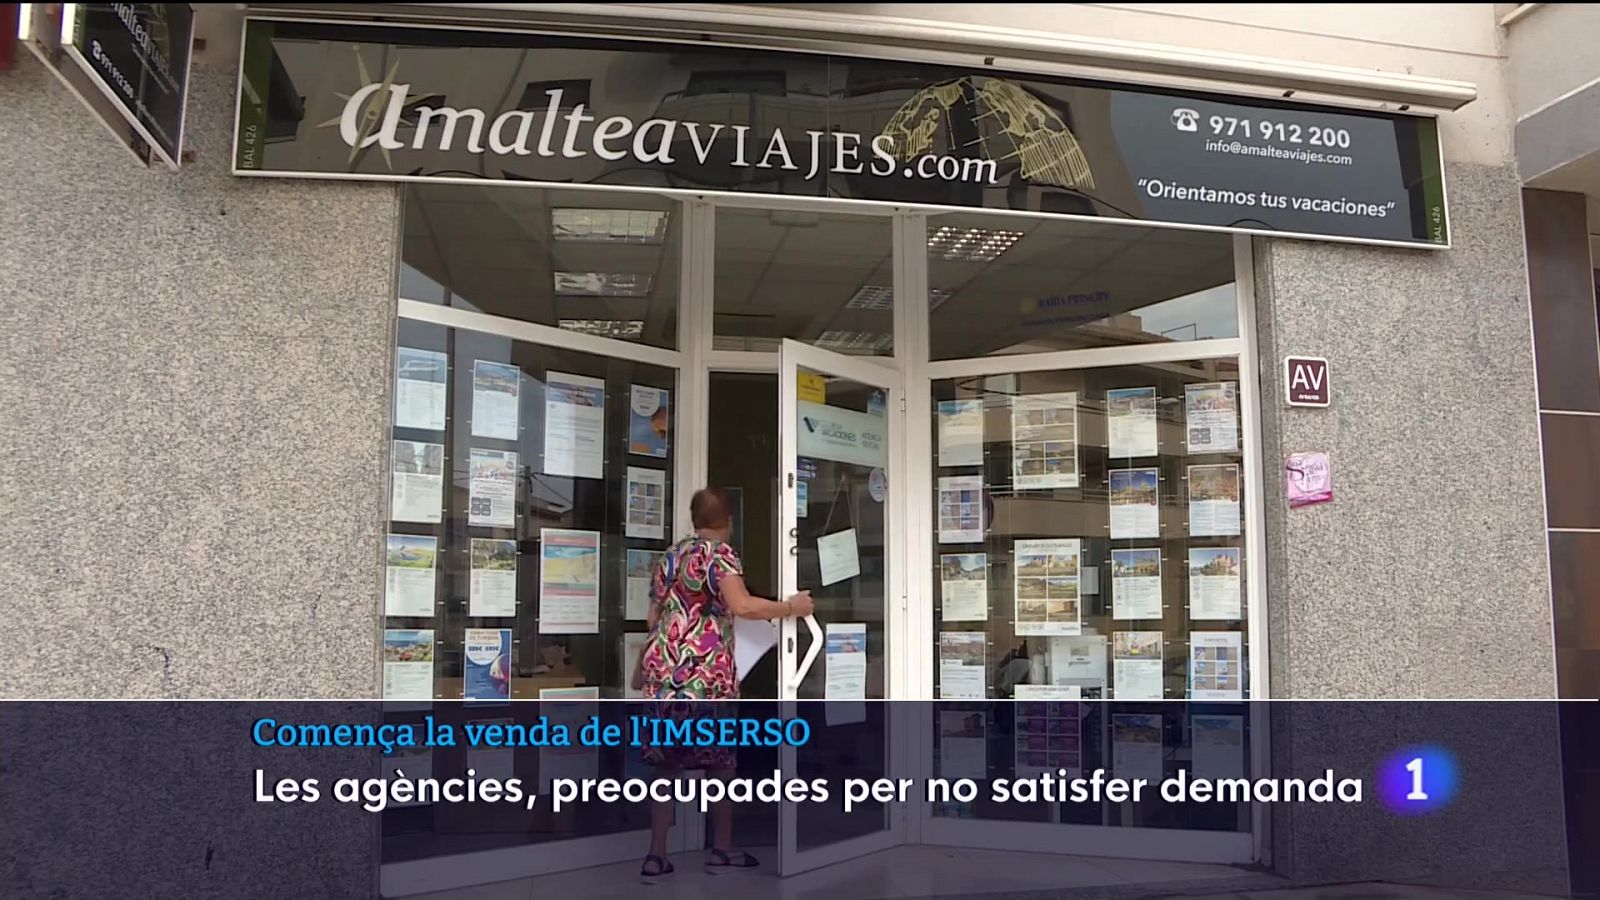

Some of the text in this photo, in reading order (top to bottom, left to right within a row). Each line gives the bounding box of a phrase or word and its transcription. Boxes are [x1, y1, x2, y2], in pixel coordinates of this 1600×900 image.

[1209, 115, 1351, 149] 971 912 200
[243, 124, 257, 168] BAL 426
[1205, 138, 1353, 166] info@amalteaviajes.com
[1260, 191, 1287, 209] tus
[1432, 206, 1441, 224] 426
[1291, 364, 1325, 391] AV
